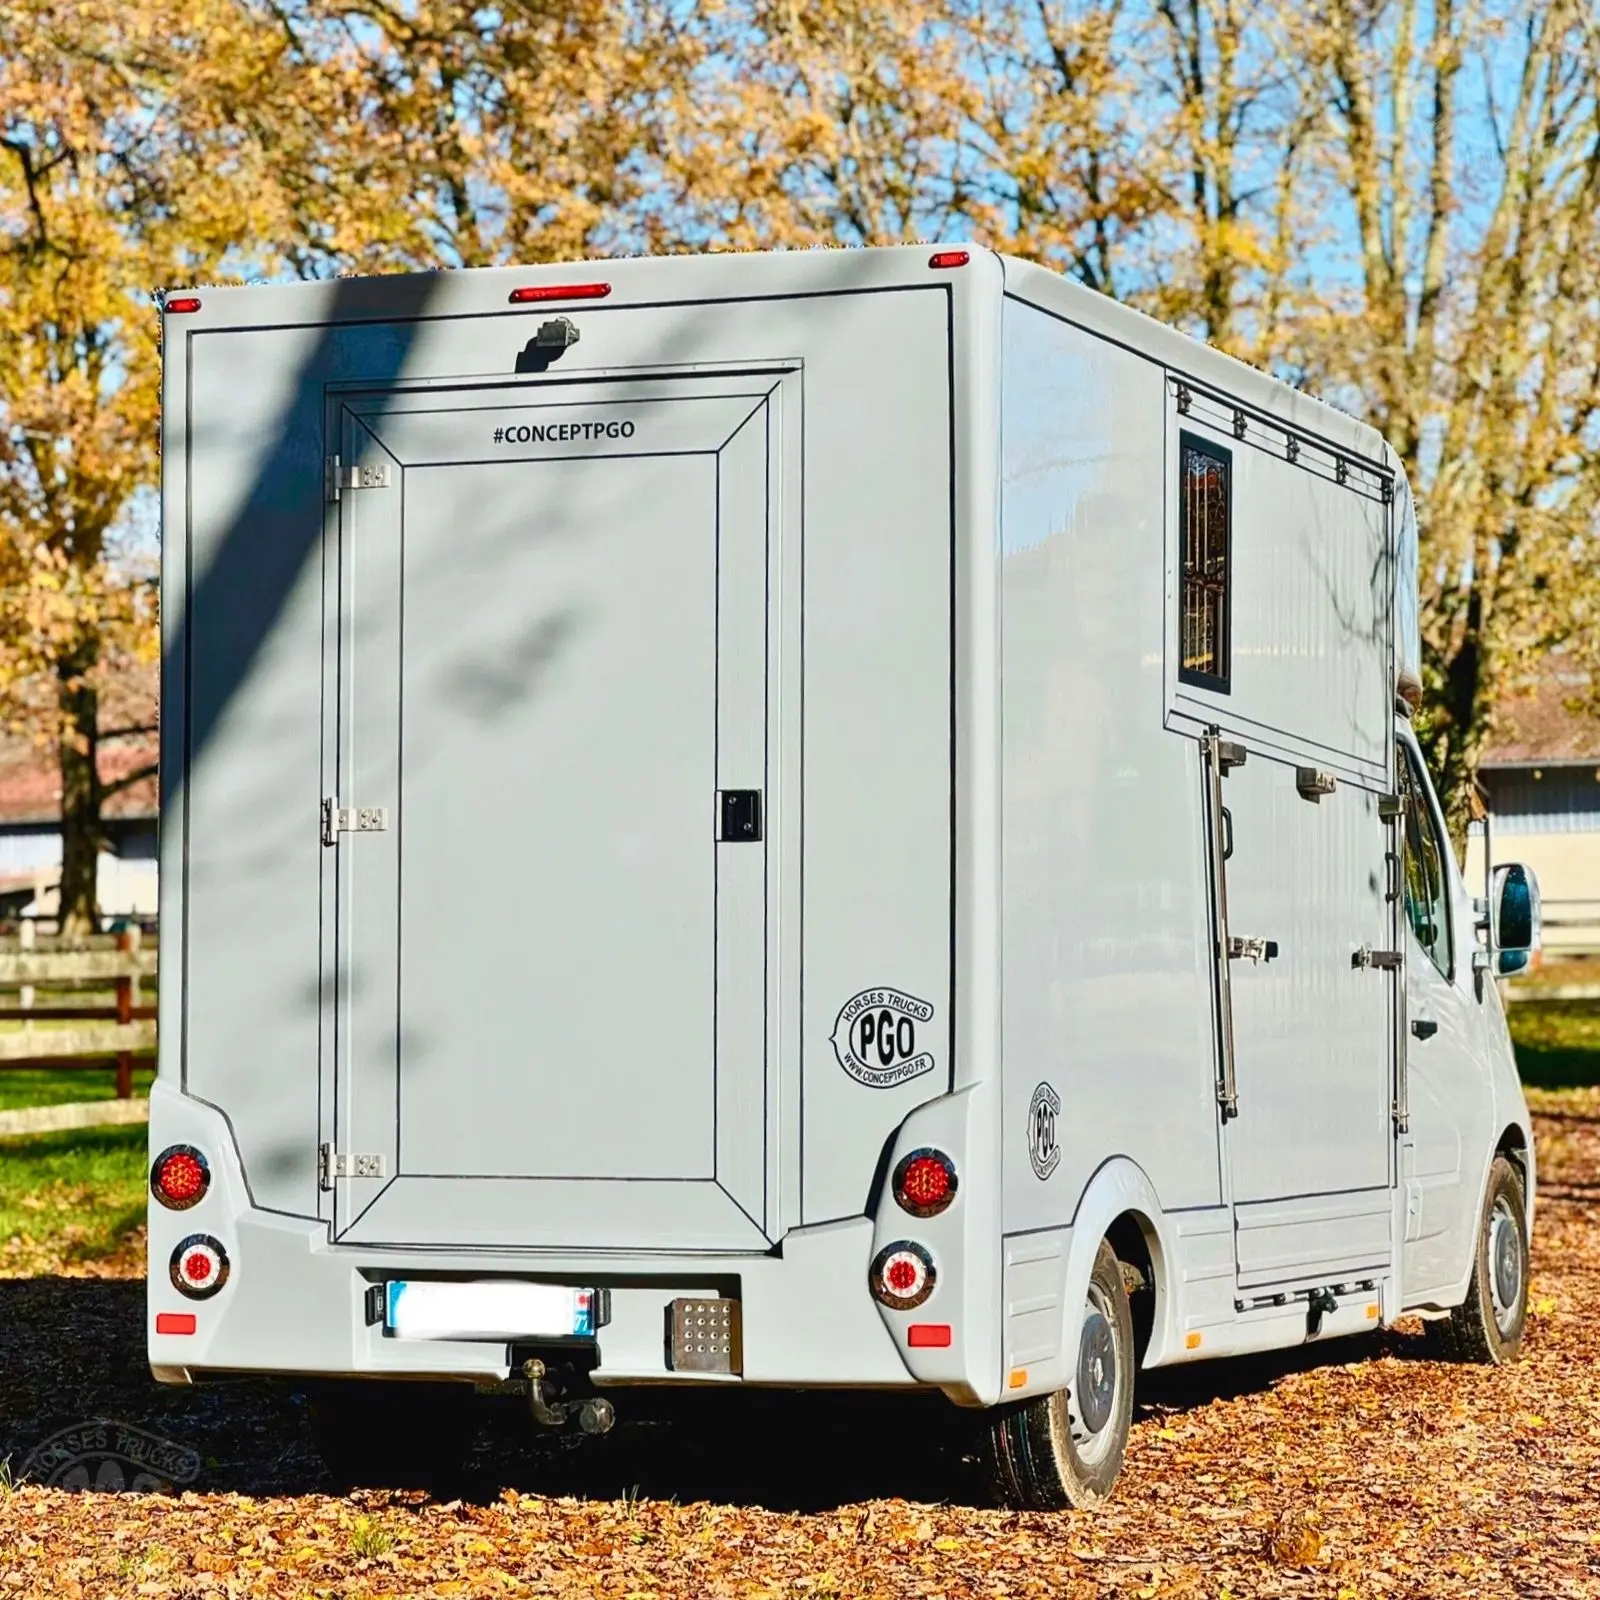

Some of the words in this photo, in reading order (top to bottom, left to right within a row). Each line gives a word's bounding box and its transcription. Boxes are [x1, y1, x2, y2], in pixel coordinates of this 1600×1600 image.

[493, 421, 635, 443] #CONCEPTPGO
[843, 992, 885, 1022] HORSES
[888, 993, 928, 1018] TRUCKS
[860, 1009, 915, 1066] PGO
[844, 1052, 926, 1084] WWW.CONCEPTPGO.FR
[1037, 1103, 1054, 1158] PGO
